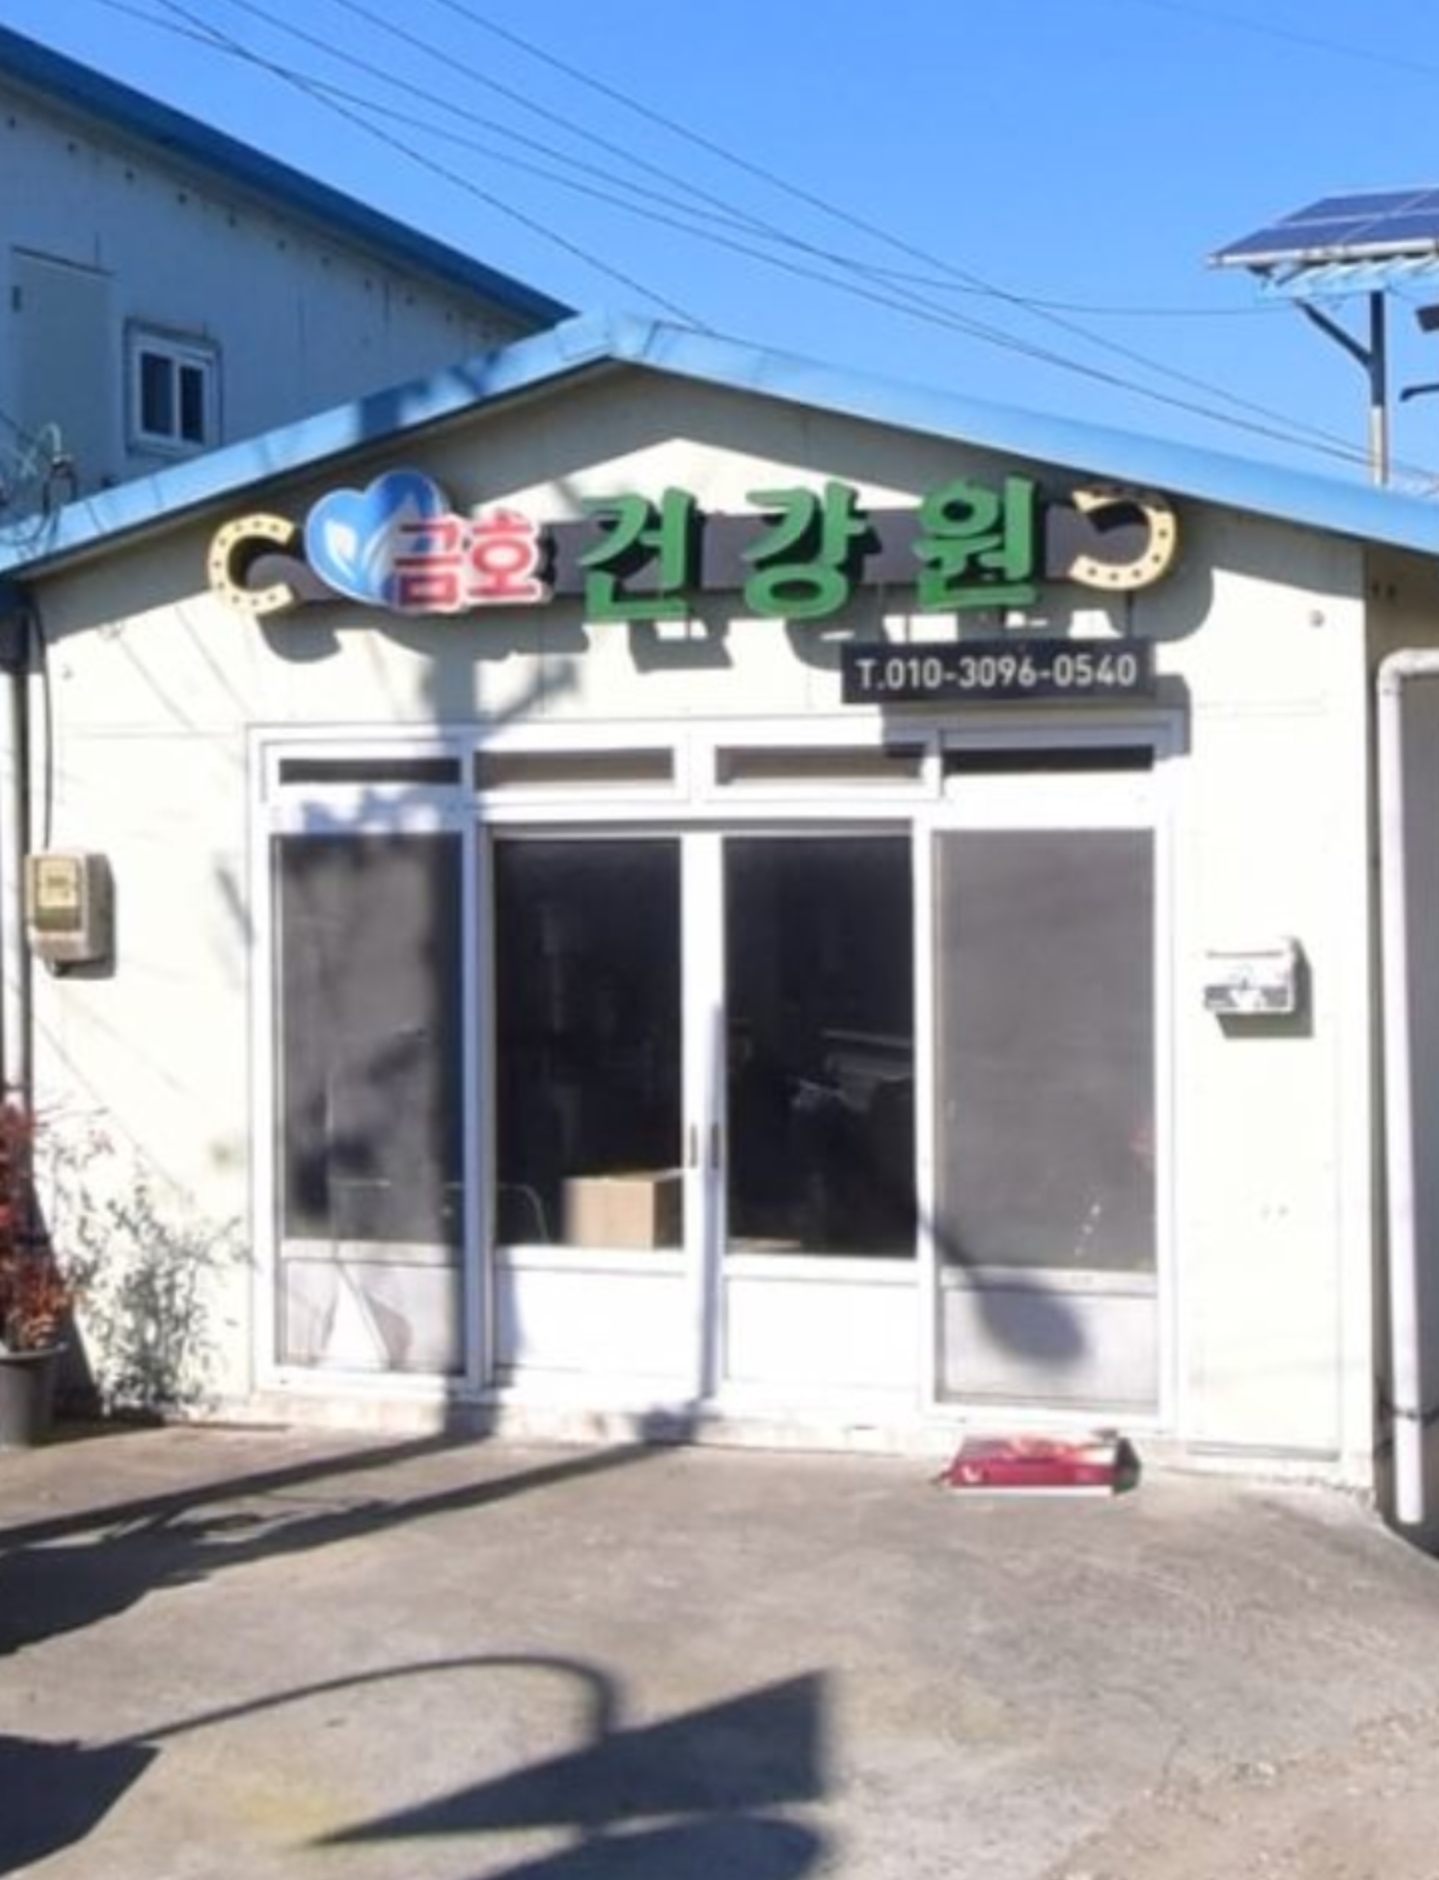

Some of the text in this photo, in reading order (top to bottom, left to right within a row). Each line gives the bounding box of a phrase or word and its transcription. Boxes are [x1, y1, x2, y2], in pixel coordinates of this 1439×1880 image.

[394, 474, 1038, 622] 금호 건강원
[855, 653, 1138, 692] T.010-3096-0540
